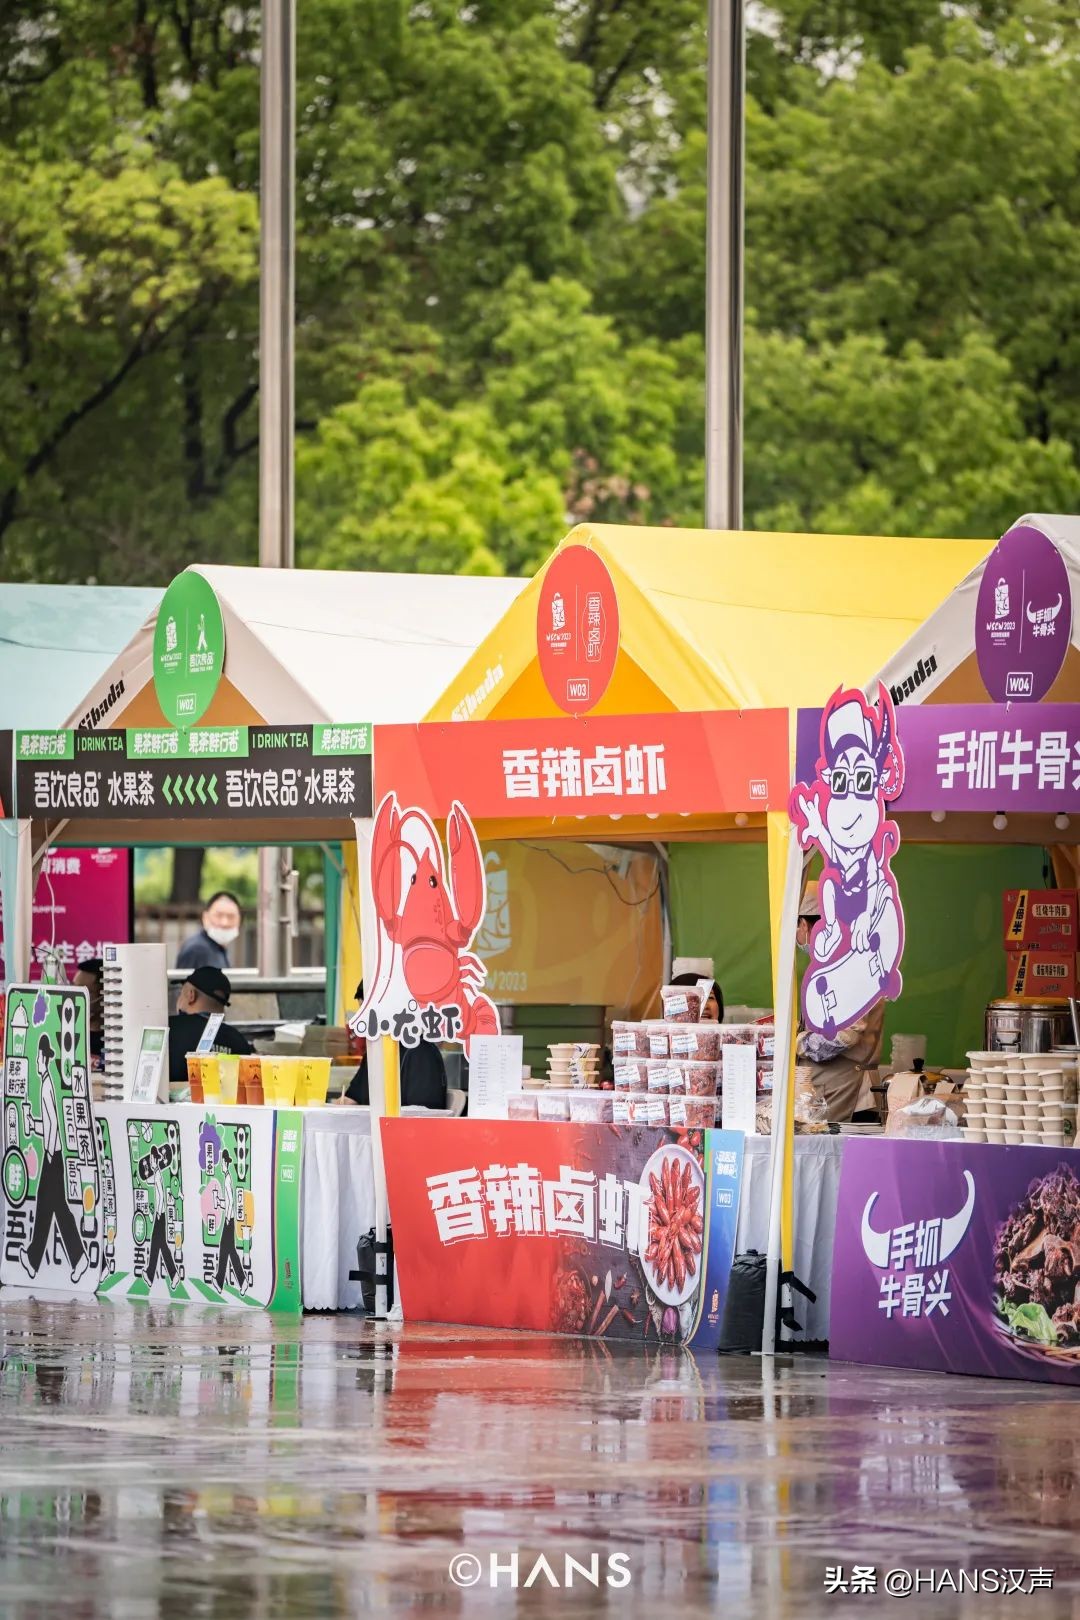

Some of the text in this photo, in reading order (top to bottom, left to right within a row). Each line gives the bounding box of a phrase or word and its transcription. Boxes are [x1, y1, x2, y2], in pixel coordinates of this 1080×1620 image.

[1033, 621, 1056, 637] 牛骨头
[1036, 607, 1053, 624] 手抓
[569, 683, 587, 697] W03
[876, 655, 937, 706] bada
[1009, 677, 1030, 692] W04
[179, 698, 194, 711] W02
[20, 732, 67, 755] 果茶鲜行者
[82, 737, 106, 751] DRINK
[107, 736, 123, 751] TEA
[134, 731, 179, 756] 果茶鲜行者
[189, 729, 239, 754] 果茶鲜行者
[257, 733, 288, 748] DRINK
[290, 732, 309, 747] TEA
[321, 727, 367, 751] 果茶鲜行者
[936, 729, 1080, 790] 手抓牛骨
[34, 767, 356, 808] 吾饮良品 水果茶 吾饮良品 水果茶
[502, 743, 667, 798] 香辣卤虾
[751, 783, 766, 796] W03
[1035, 905, 1067, 917] 红烧牛肉面
[357, 1000, 460, 1044] 小龙虾
[65, 1105, 76, 1144] NICE
[425, 1162, 654, 1257] 香辣卤虾
[890, 1217, 943, 1270] 手抓
[878, 1269, 952, 1319] 牛骨头
